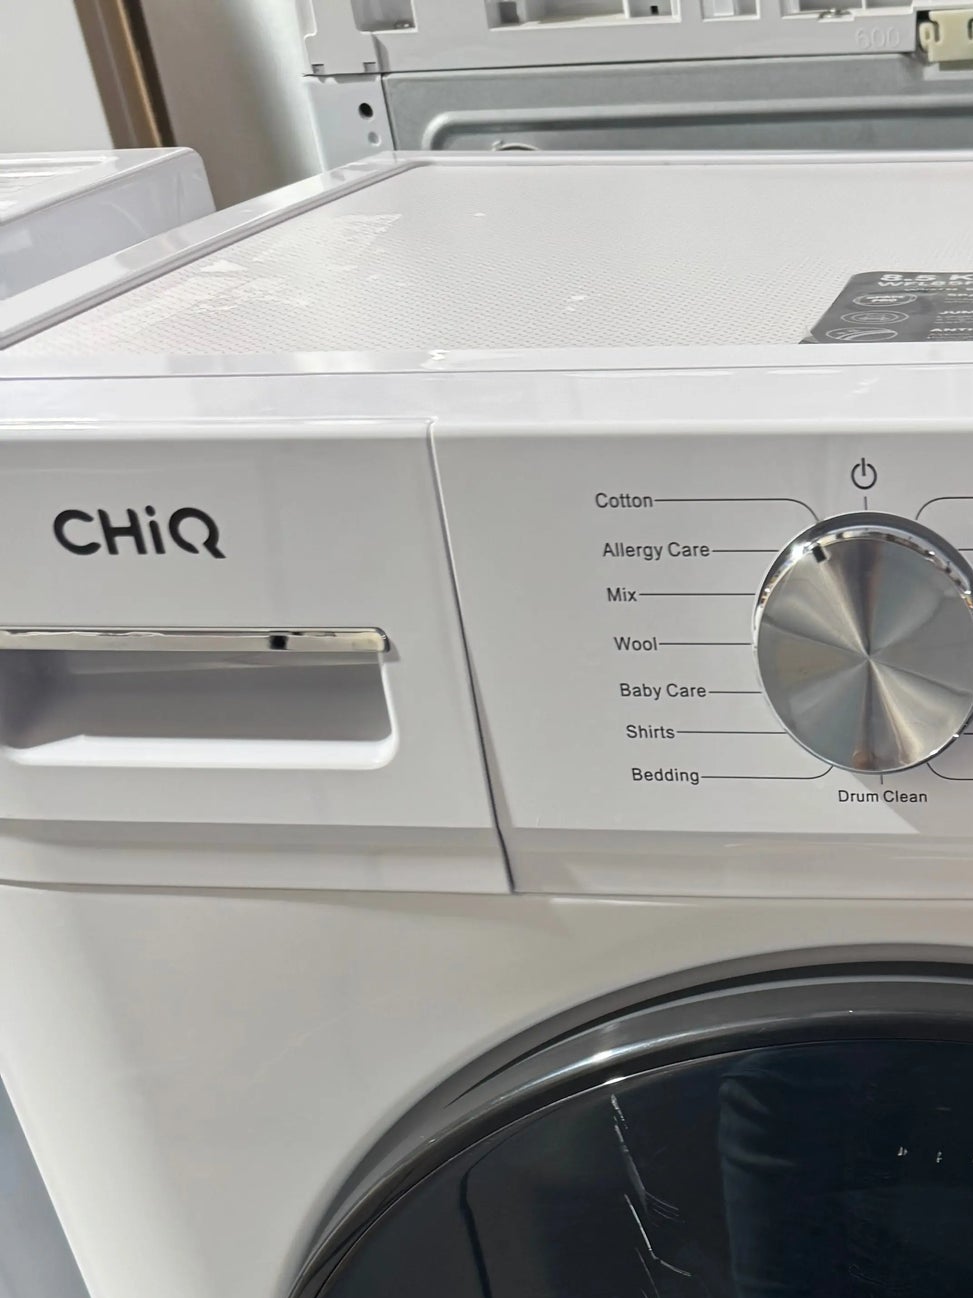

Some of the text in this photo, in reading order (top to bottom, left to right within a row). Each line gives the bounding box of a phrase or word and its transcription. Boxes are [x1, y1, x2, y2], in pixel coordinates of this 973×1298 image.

[880, 273, 937, 281] 8.5
[594, 492, 654, 509] Cotton
[52, 505, 227, 559] CHiQ
[602, 542, 711, 561] Allergy Care
[606, 587, 638, 603] Mix
[614, 636, 658, 652] Wool
[620, 683, 707, 700] Baby Care
[625, 724, 676, 740] Shirts
[631, 767, 700, 786] Bedding
[838, 789, 928, 804] Drum Clean
